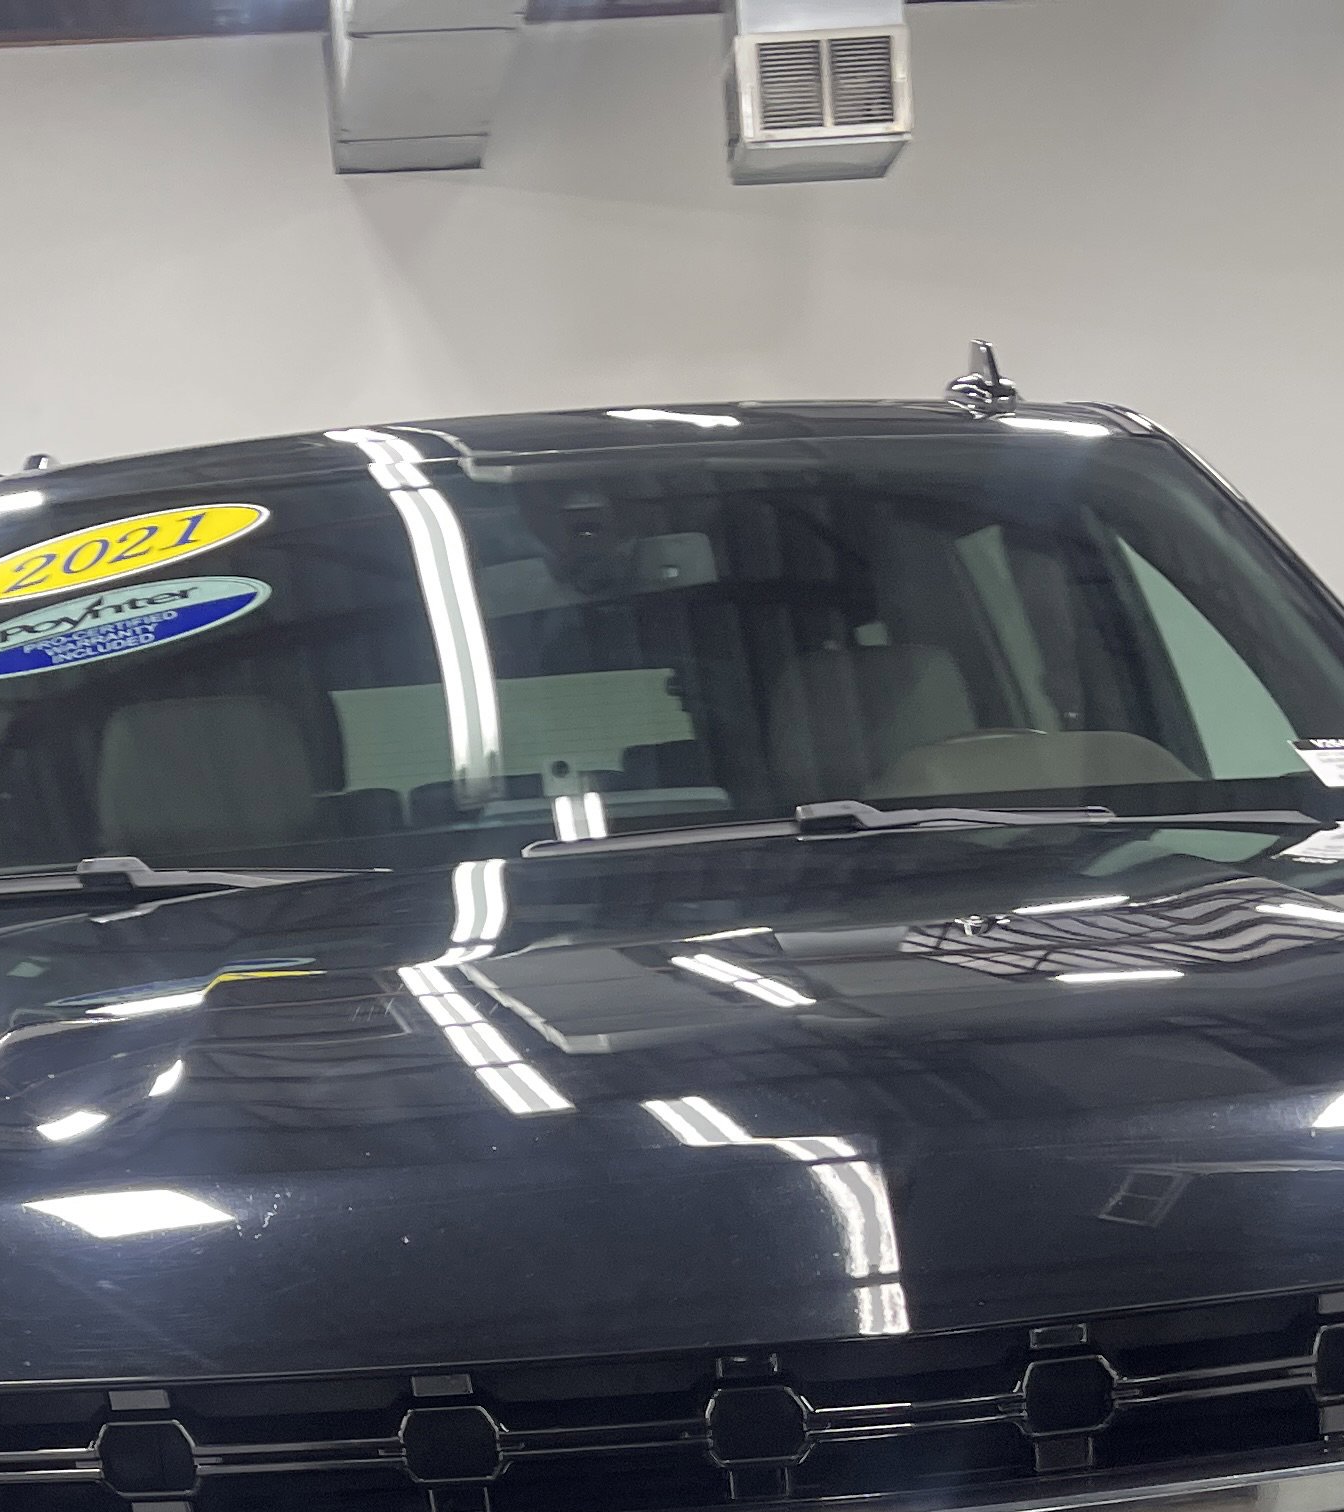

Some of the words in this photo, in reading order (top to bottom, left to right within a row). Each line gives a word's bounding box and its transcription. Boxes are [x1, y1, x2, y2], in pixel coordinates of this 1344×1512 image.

[2, 512, 207, 594] 2021
[45, 622, 159, 656] WARRANTY
[51, 632, 156, 664] INCLUDED
